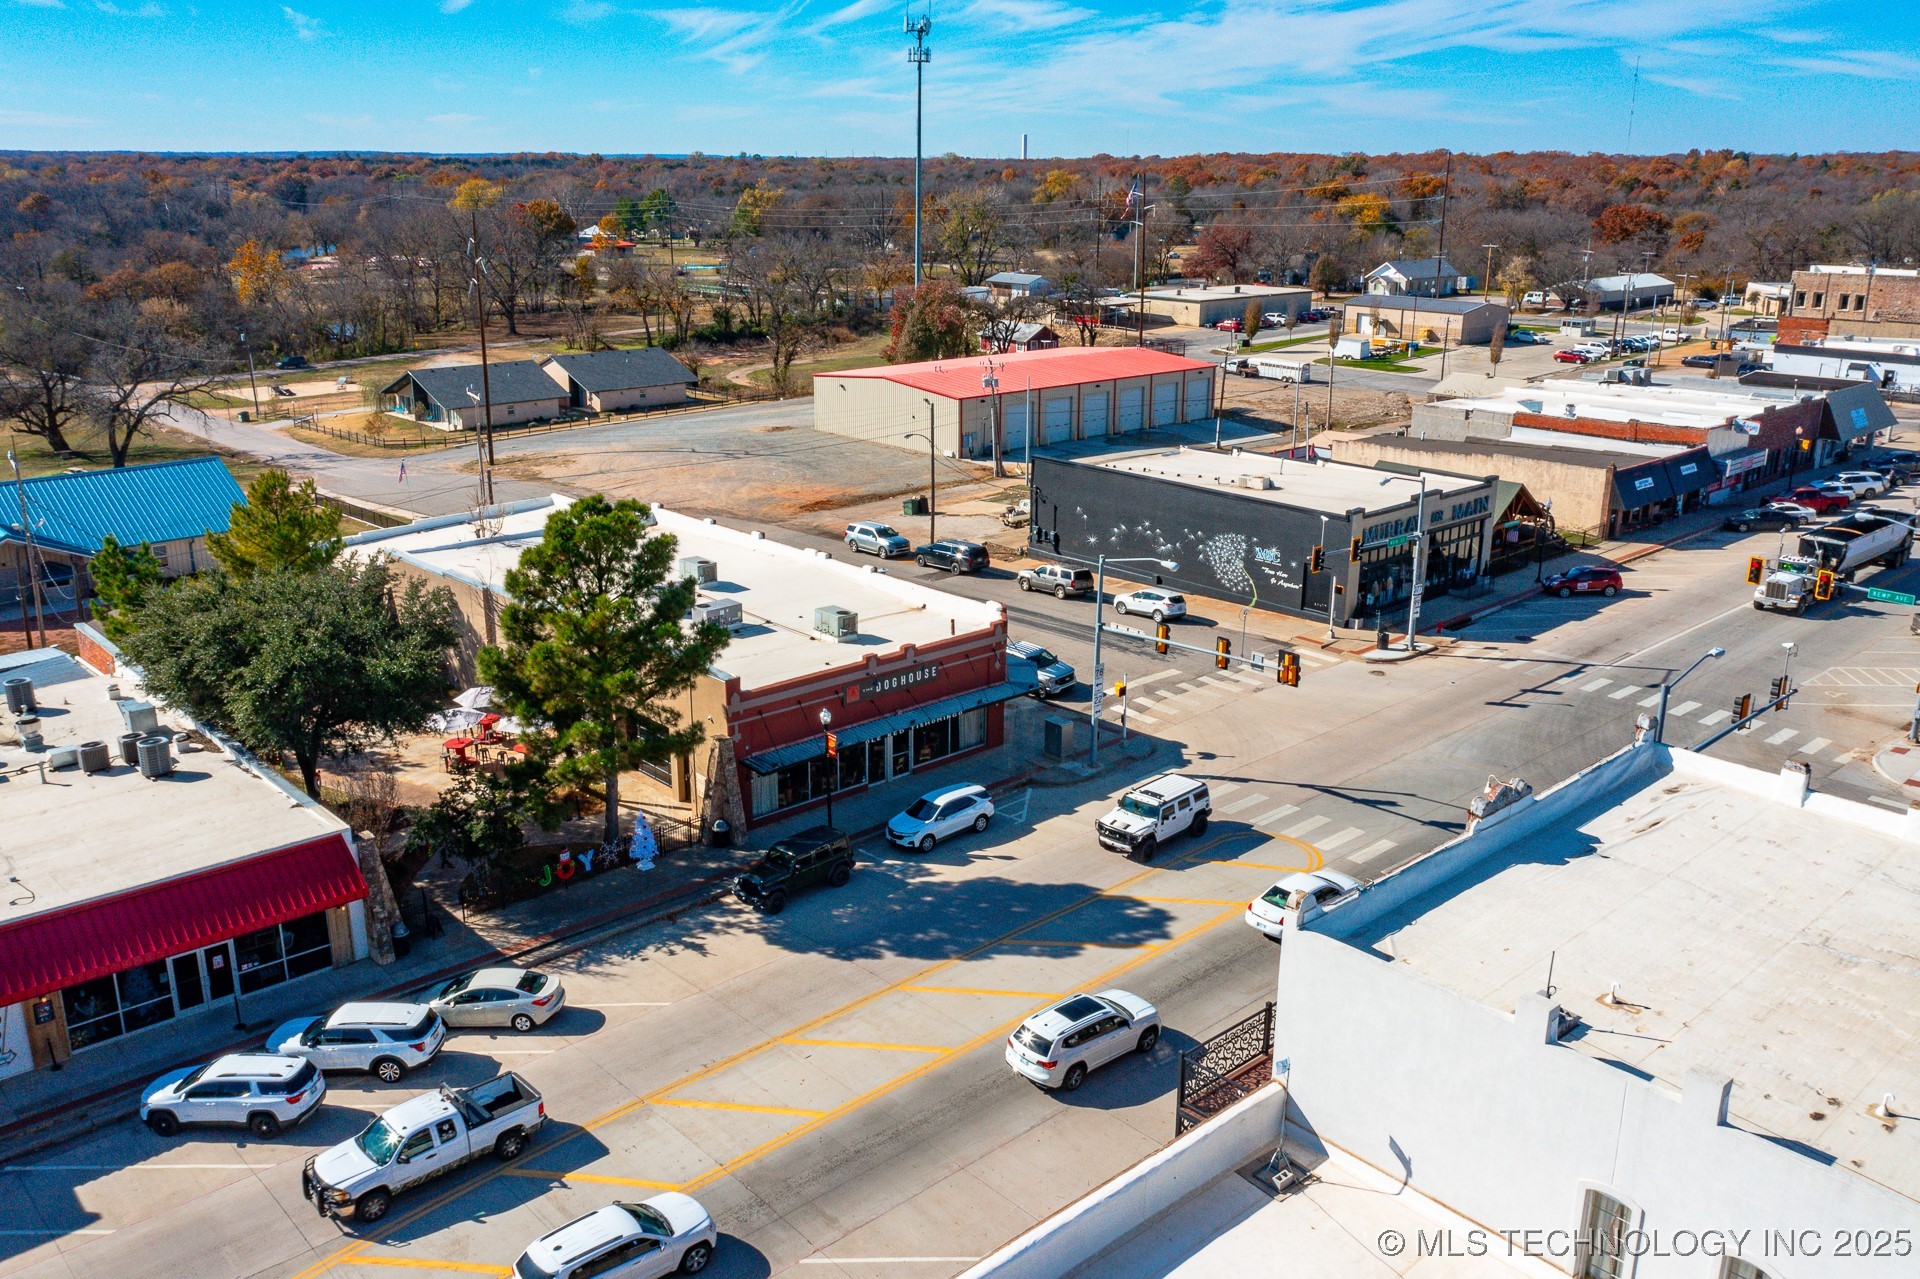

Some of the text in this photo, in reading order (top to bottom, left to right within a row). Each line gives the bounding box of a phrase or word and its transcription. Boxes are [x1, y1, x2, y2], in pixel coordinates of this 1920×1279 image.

[1452, 496, 1490, 520] MAIN
[1255, 547, 1281, 563] MSC
[1873, 591, 1891, 599] KEMP
[875, 666, 937, 693] DOGHOUSE
[865, 735, 881, 744] OLE
[911, 711, 963, 730] TISHOMINGO
[540, 846, 594, 886] JOY
